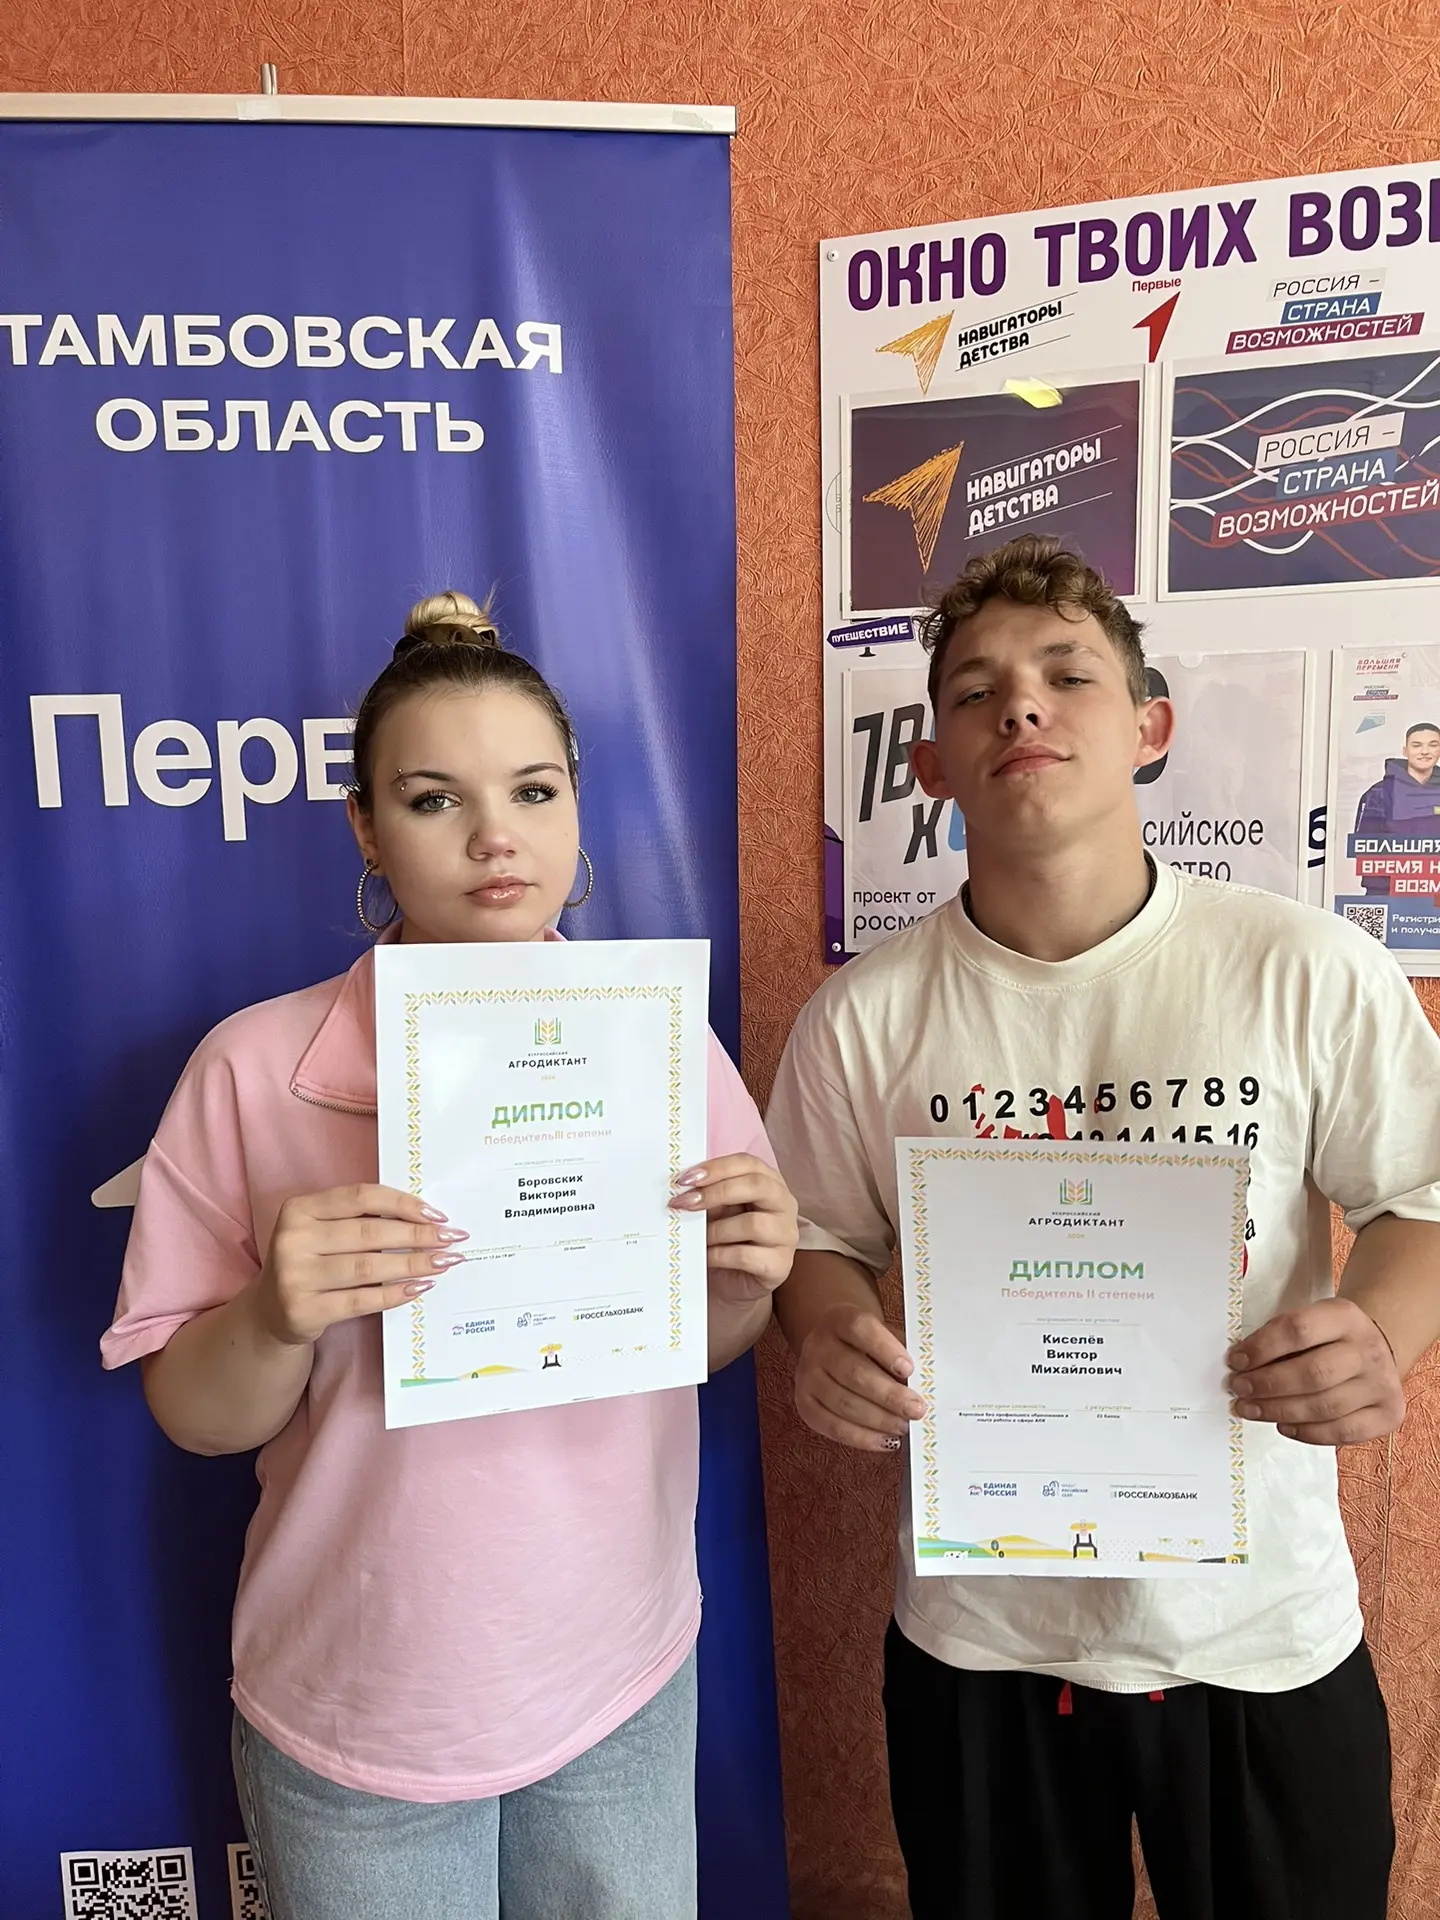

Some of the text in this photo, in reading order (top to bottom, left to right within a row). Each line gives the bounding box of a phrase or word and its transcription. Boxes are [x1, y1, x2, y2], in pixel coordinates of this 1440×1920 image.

[848, 232, 1006, 311] ОКНО
[1034, 198, 1257, 288] ТВОИХ
[1132, 276, 1181, 294] Первые
[1273, 274, 1359, 298] РОССИЯ
[1287, 297, 1371, 321] СТРАНА
[958, 301, 1062, 348] НАВИГАТОРЫ
[1232, 315, 1413, 351] ВОЗМОЖНОСТЕЙ
[0, 313, 563, 374] ТАМБОВСКАЯ
[959, 332, 1029, 369] ДЕТСТВА
[95, 398, 485, 452] ОБЛАСТЬ
[1264, 425, 1370, 463] РОССИЯ
[966, 438, 1102, 502] НАВИГАТОРЫ
[1283, 457, 1386, 495] СТРАНА
[968, 483, 1059, 535] ДЕТСТВА
[1218, 478, 1439, 539] ВОЗМОЖНОСТЕЙ
[831, 622, 909, 644] ПУТЕШЕСТВИЕ
[1362, 860, 1423, 874] ВРЕМЯ
[853, 891, 936, 907] проект от
[508, 1057, 587, 1069] АГРОДИКТАНТ
[930, 1076, 1260, 1122] 0 1 2 3 4 5 6 7 8 9
[491, 1100, 604, 1129] ДИПЛОМ
[566, 1129, 612, 1140] степени
[518, 1173, 583, 1188] Боровских
[519, 1188, 577, 1202] Виктория
[504, 1202, 595, 1219] Владимировна
[1029, 1218, 1125, 1228] АГРОДИКТАНТ
[1009, 1259, 1144, 1281] ДИПЛОМ
[1001, 1288, 1083, 1299] Победитель
[1098, 1290, 1154, 1300] степени
[581, 1306, 643, 1320] РОССЕЛЬХОЗБАНК
[465, 1319, 495, 1328] ЕДИНАЯ
[465, 1325, 495, 1335] РОССИЯ
[1042, 1334, 1104, 1345] Киселёв
[1047, 1349, 1098, 1362] Виктор
[1031, 1363, 1122, 1376] Михайлович
[1118, 1490, 1198, 1500] РОССЕЛЬХОЗБАНК
